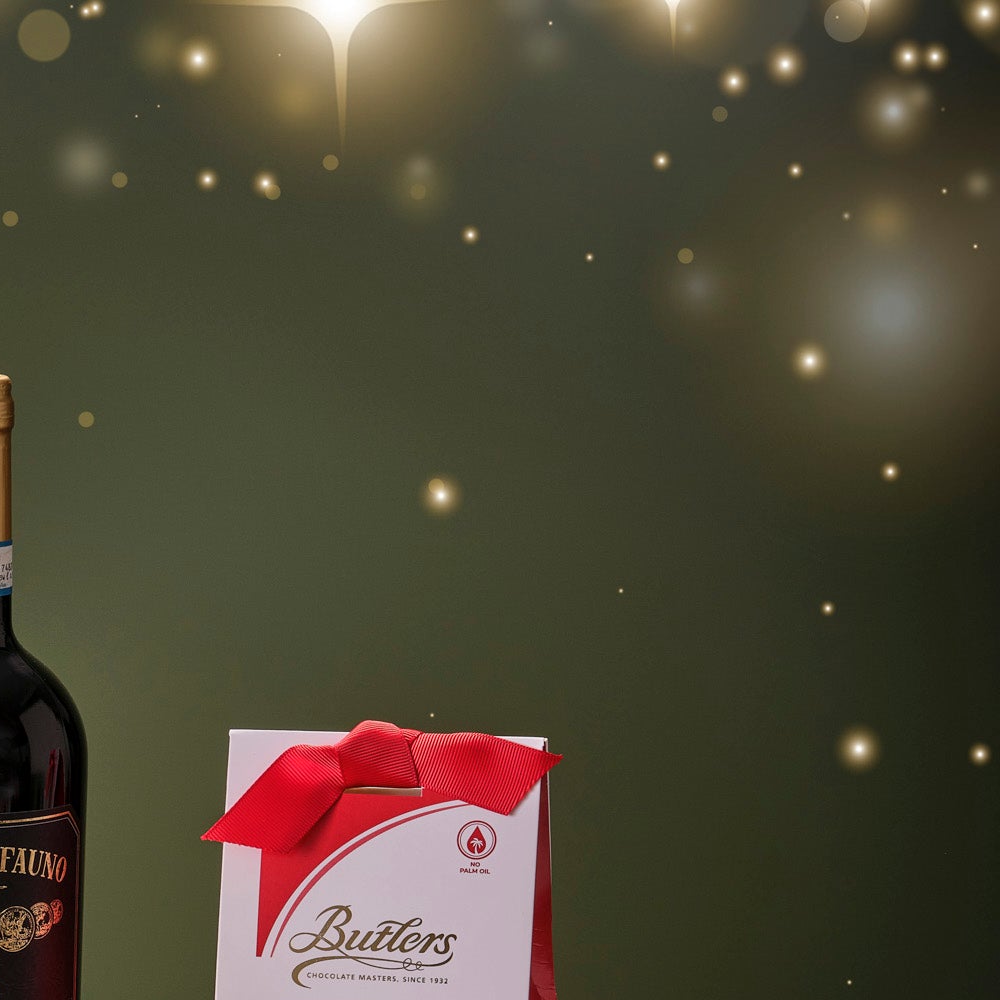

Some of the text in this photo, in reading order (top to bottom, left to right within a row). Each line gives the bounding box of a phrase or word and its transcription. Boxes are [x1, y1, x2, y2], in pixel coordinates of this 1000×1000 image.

[289, 905, 457, 956] Butlers
[306, 972, 449, 985] CHOCOLATE MASTERS, SINCE 1932
